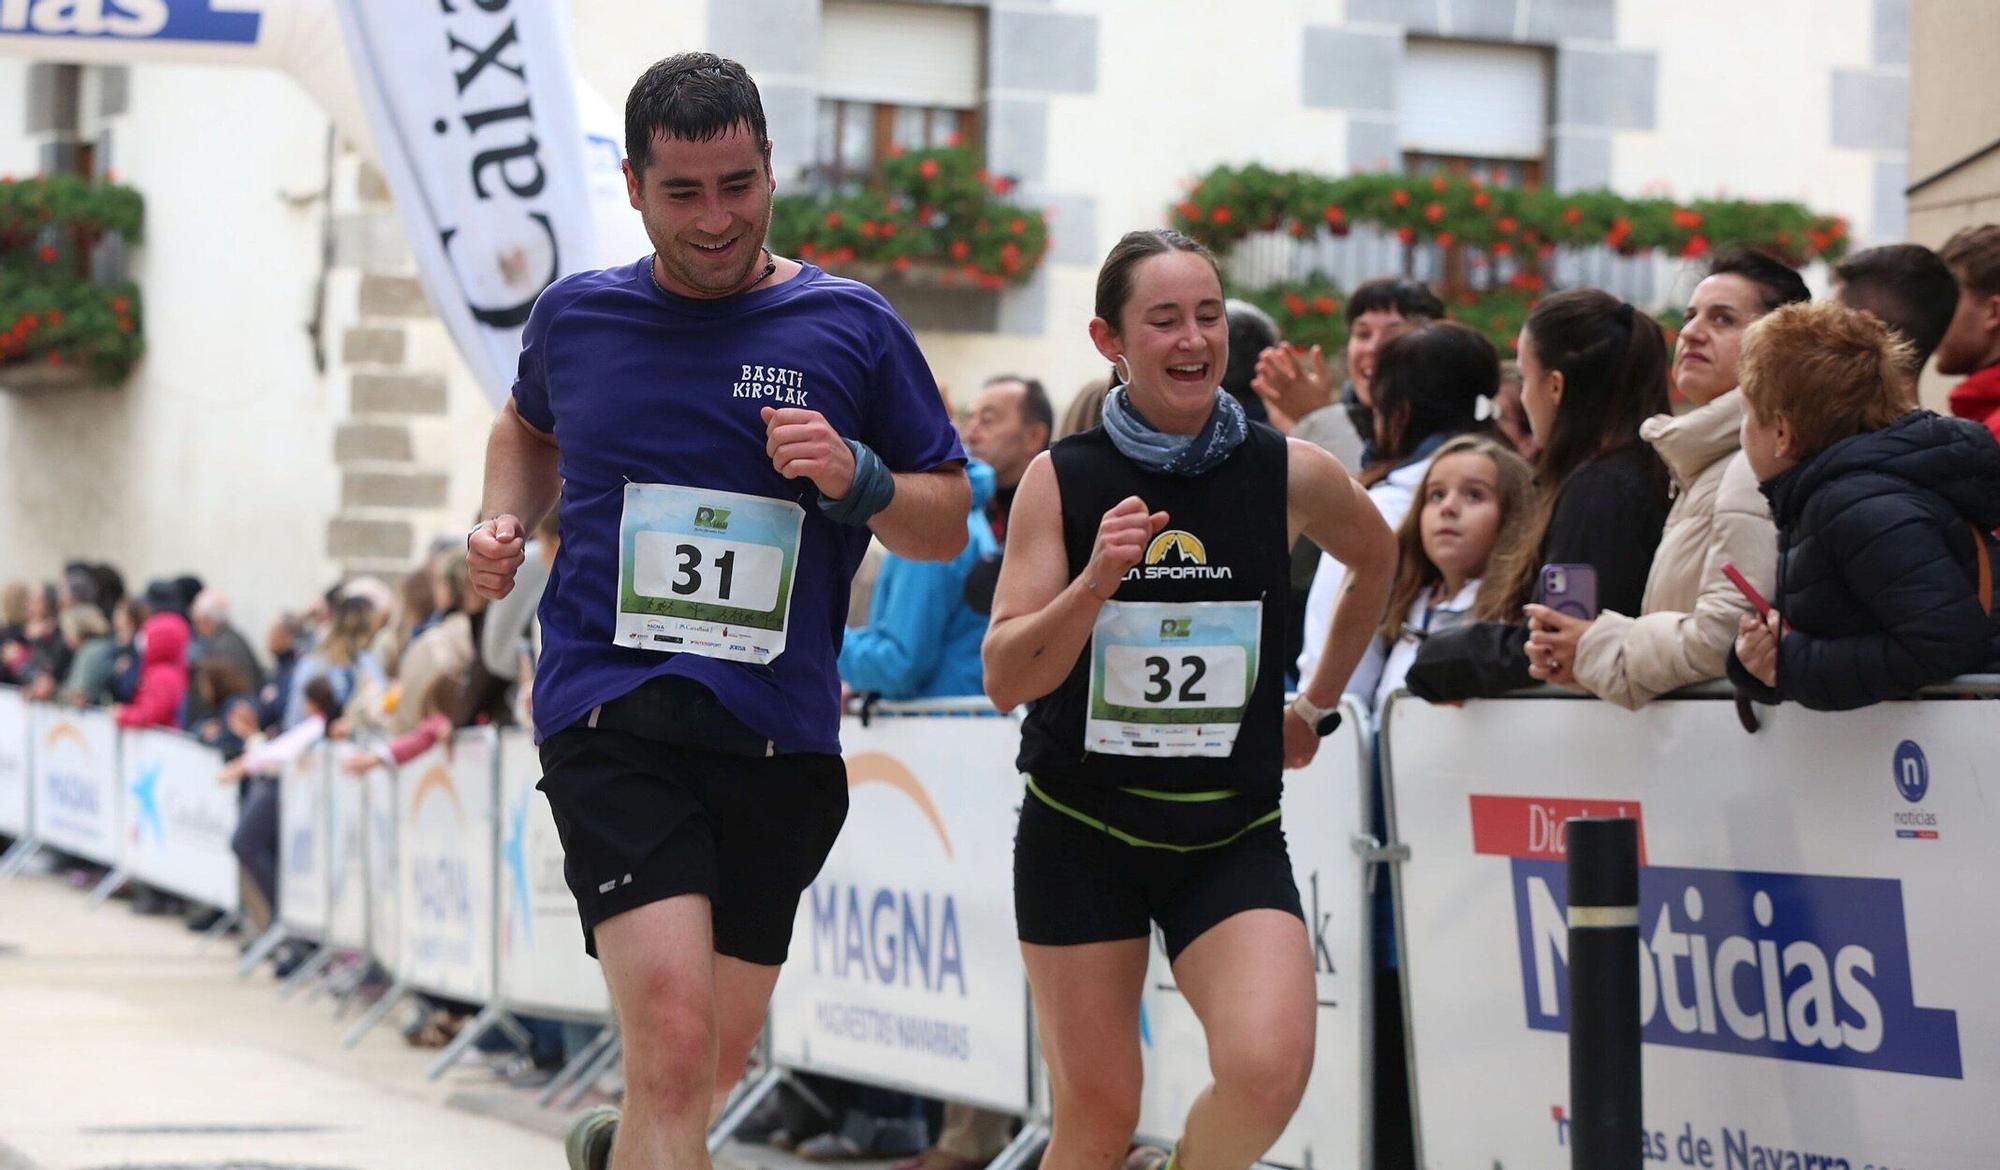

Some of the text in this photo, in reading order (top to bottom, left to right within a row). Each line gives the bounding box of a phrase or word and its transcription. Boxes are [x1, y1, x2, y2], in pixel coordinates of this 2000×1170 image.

[434, 0, 560, 329] Caix
[671, 544, 736, 600] 31
[1145, 566, 1233, 579] SPORTIVA
[1144, 655, 1207, 702] 32
[810, 882, 968, 998] MAGNA
[1677, 1121, 1714, 1168] de
